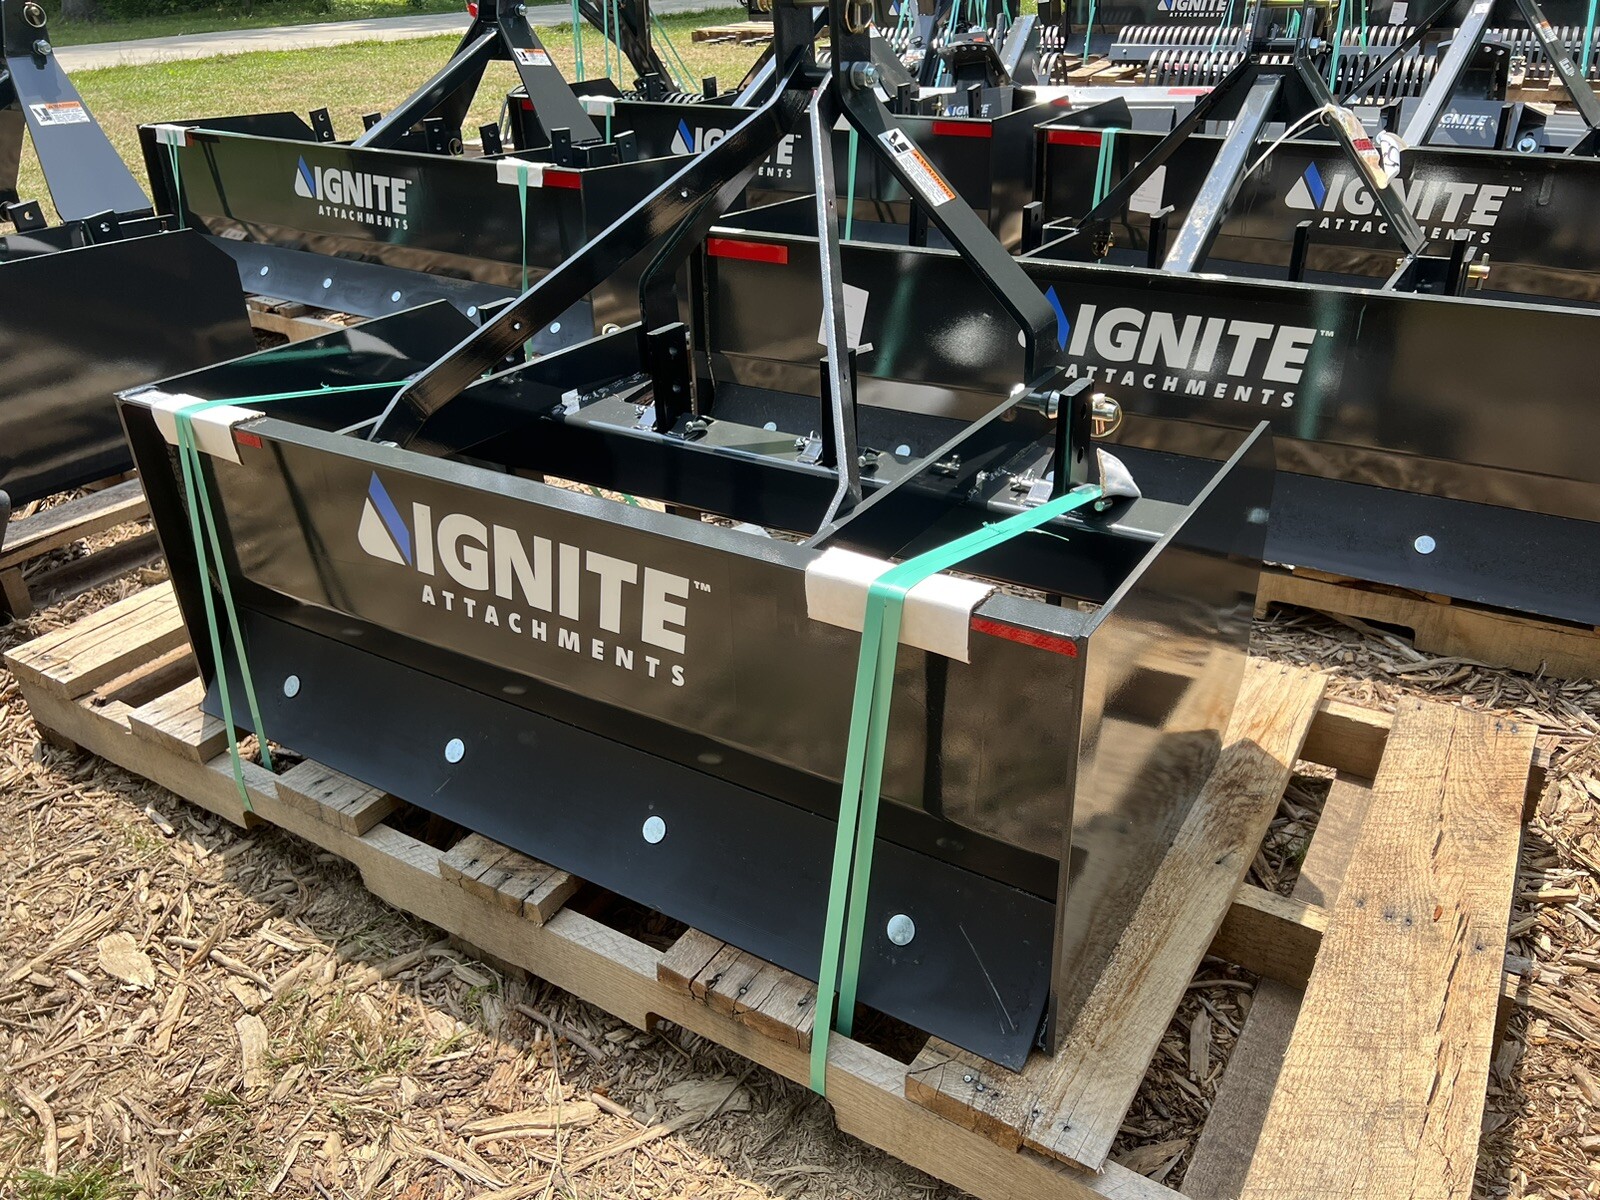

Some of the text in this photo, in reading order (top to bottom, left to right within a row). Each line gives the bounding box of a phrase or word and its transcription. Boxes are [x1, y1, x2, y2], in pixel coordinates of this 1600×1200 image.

[1440, 113, 1487, 126] GNITE
[314, 166, 407, 215] IGNITE
[318, 205, 409, 230] ATTACHMENTS
[1068, 303, 1318, 384] IGNITE
[1064, 363, 1295, 408] ATTACHMENTS
[412, 501, 690, 655] IGNITE
[421, 584, 686, 687] ATTACHMENTS
